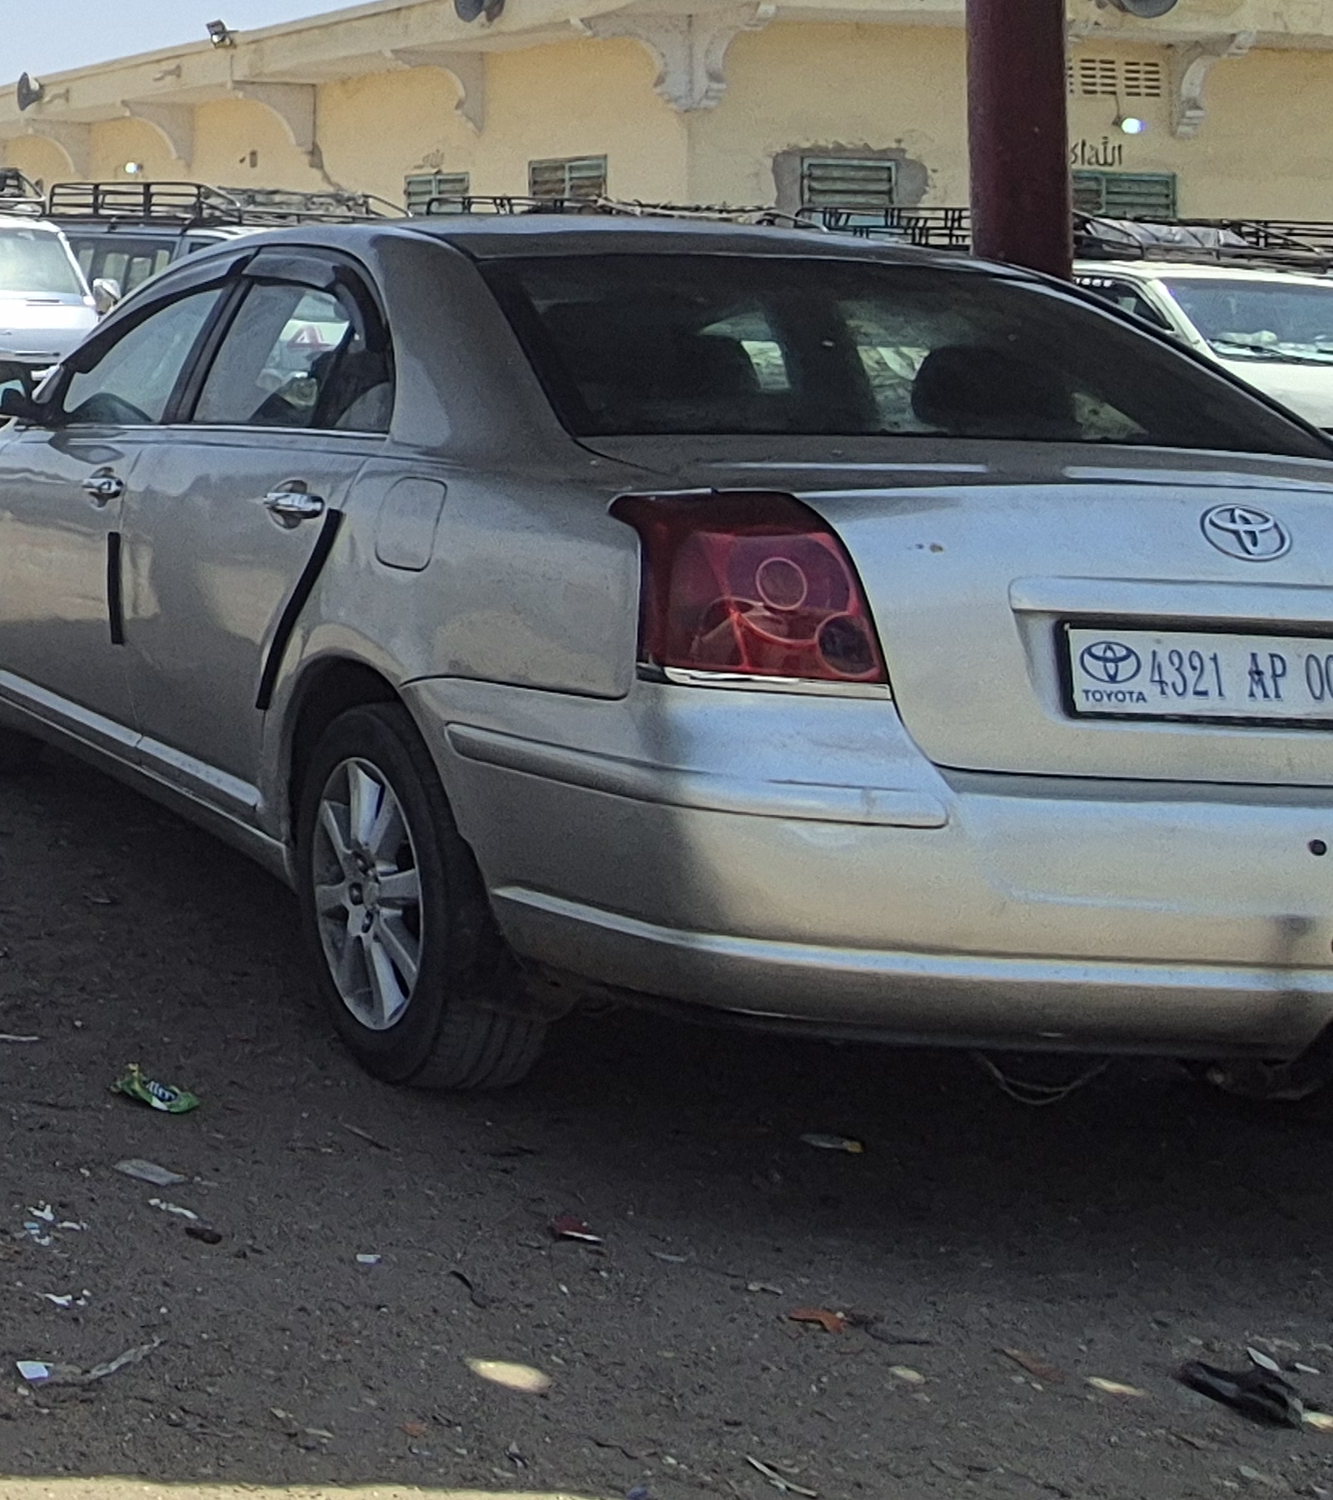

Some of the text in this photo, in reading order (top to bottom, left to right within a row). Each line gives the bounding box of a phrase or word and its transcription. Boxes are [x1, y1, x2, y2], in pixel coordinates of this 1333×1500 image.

[1149, 648, 1226, 699] 4321
[1247, 651, 1287, 701] AP
[1082, 688, 1148, 704] TOYOTA
